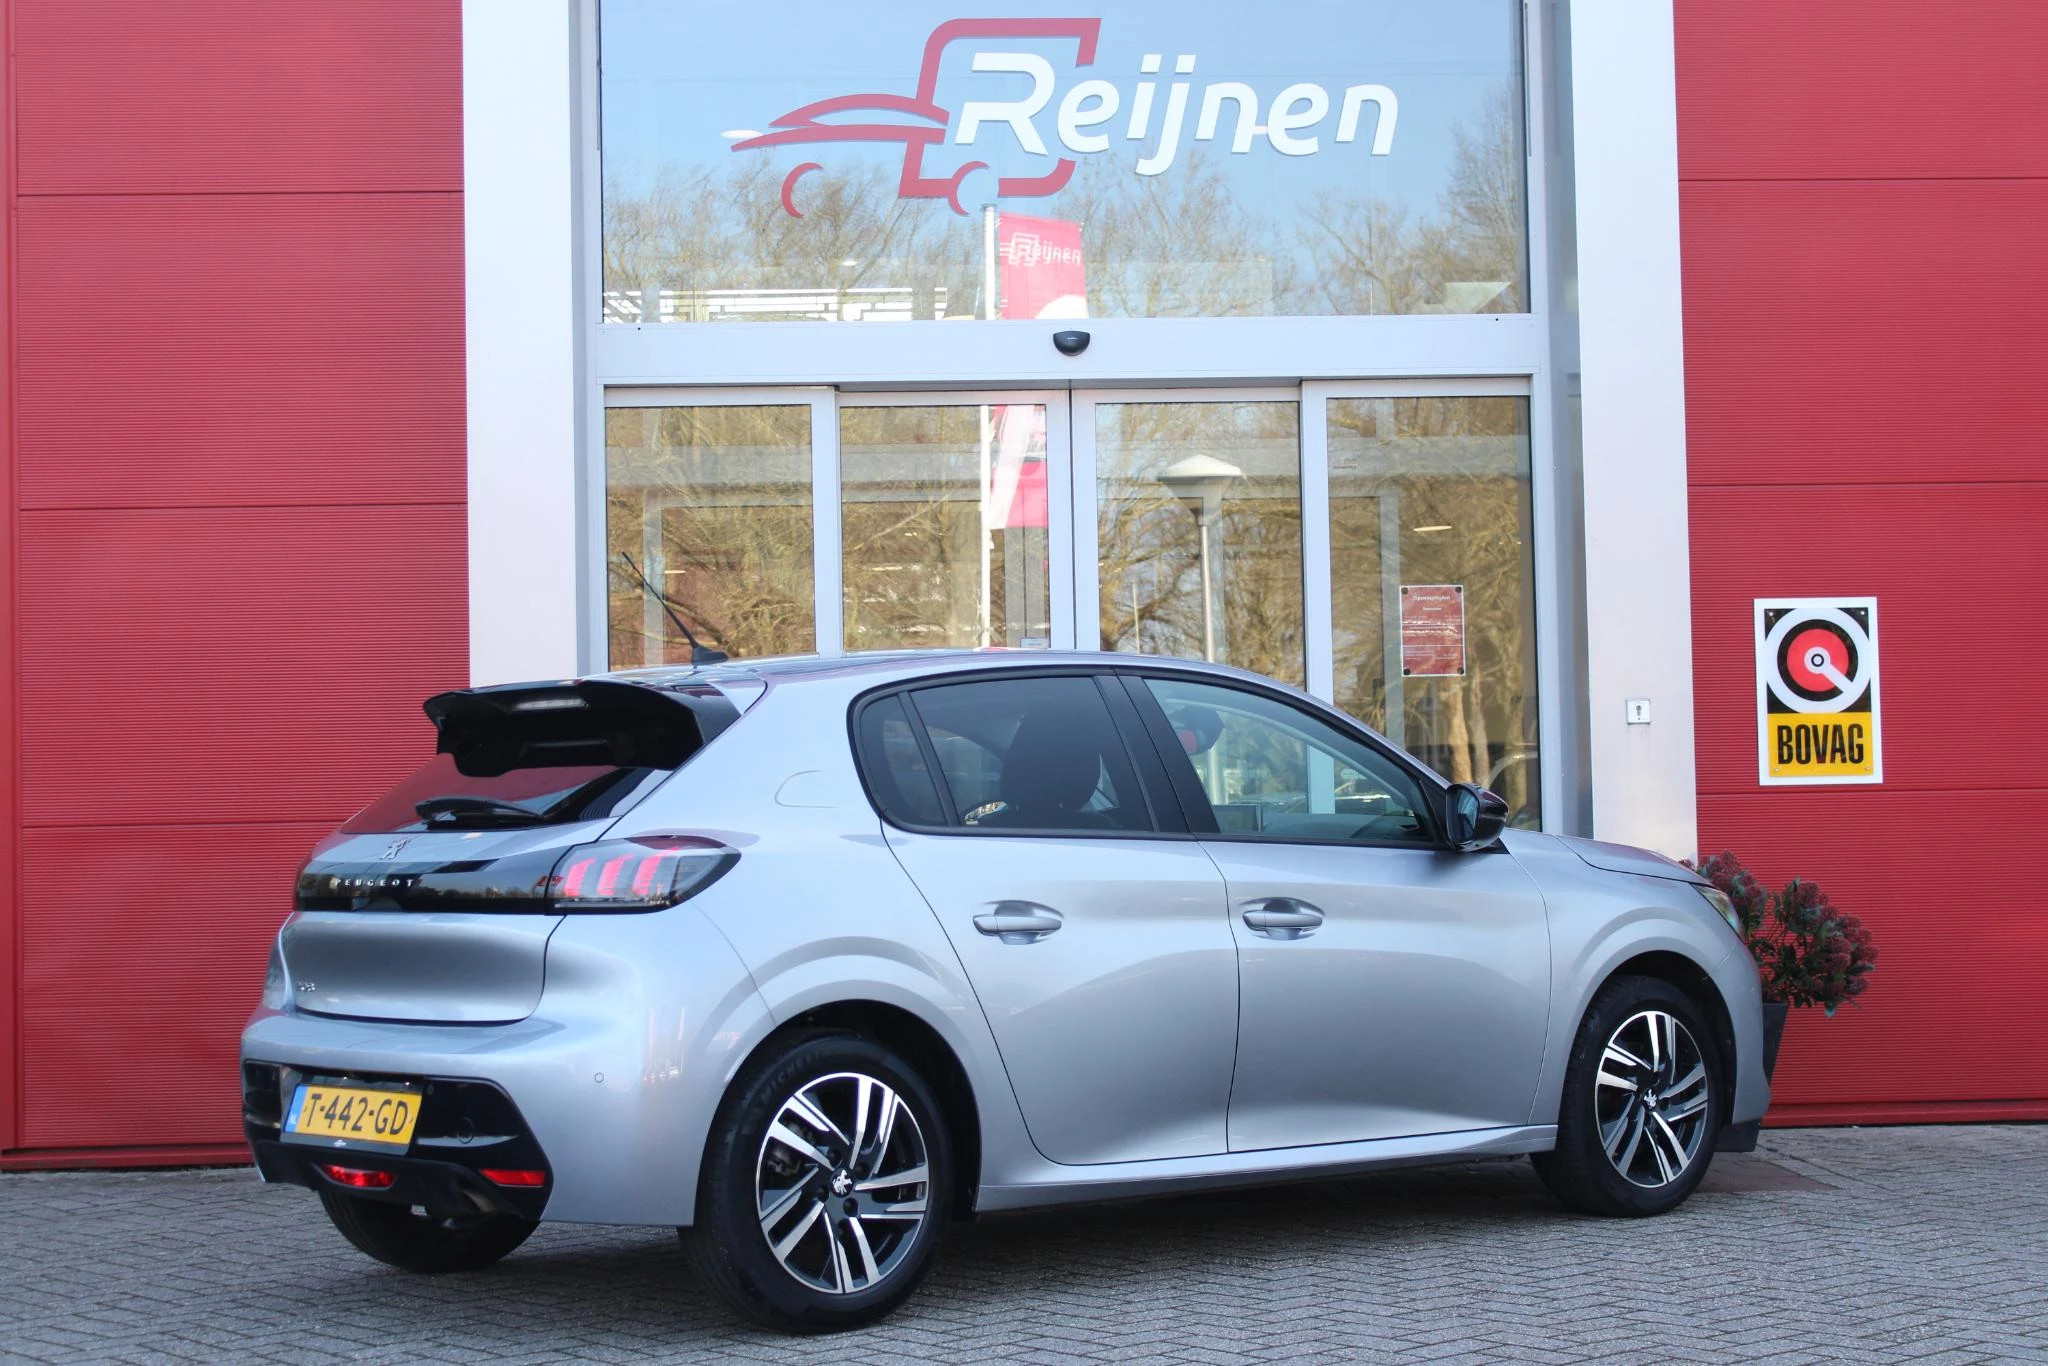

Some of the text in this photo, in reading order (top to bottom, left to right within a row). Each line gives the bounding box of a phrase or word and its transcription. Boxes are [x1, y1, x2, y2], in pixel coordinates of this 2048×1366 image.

[955, 53, 1399, 176] Reijnen
[1013, 236, 1082, 268] Reijnen
[1777, 723, 1864, 765] BOVAG
[335, 879, 414, 887] PEUGEOT
[307, 1093, 409, 1135] T-442-GD
